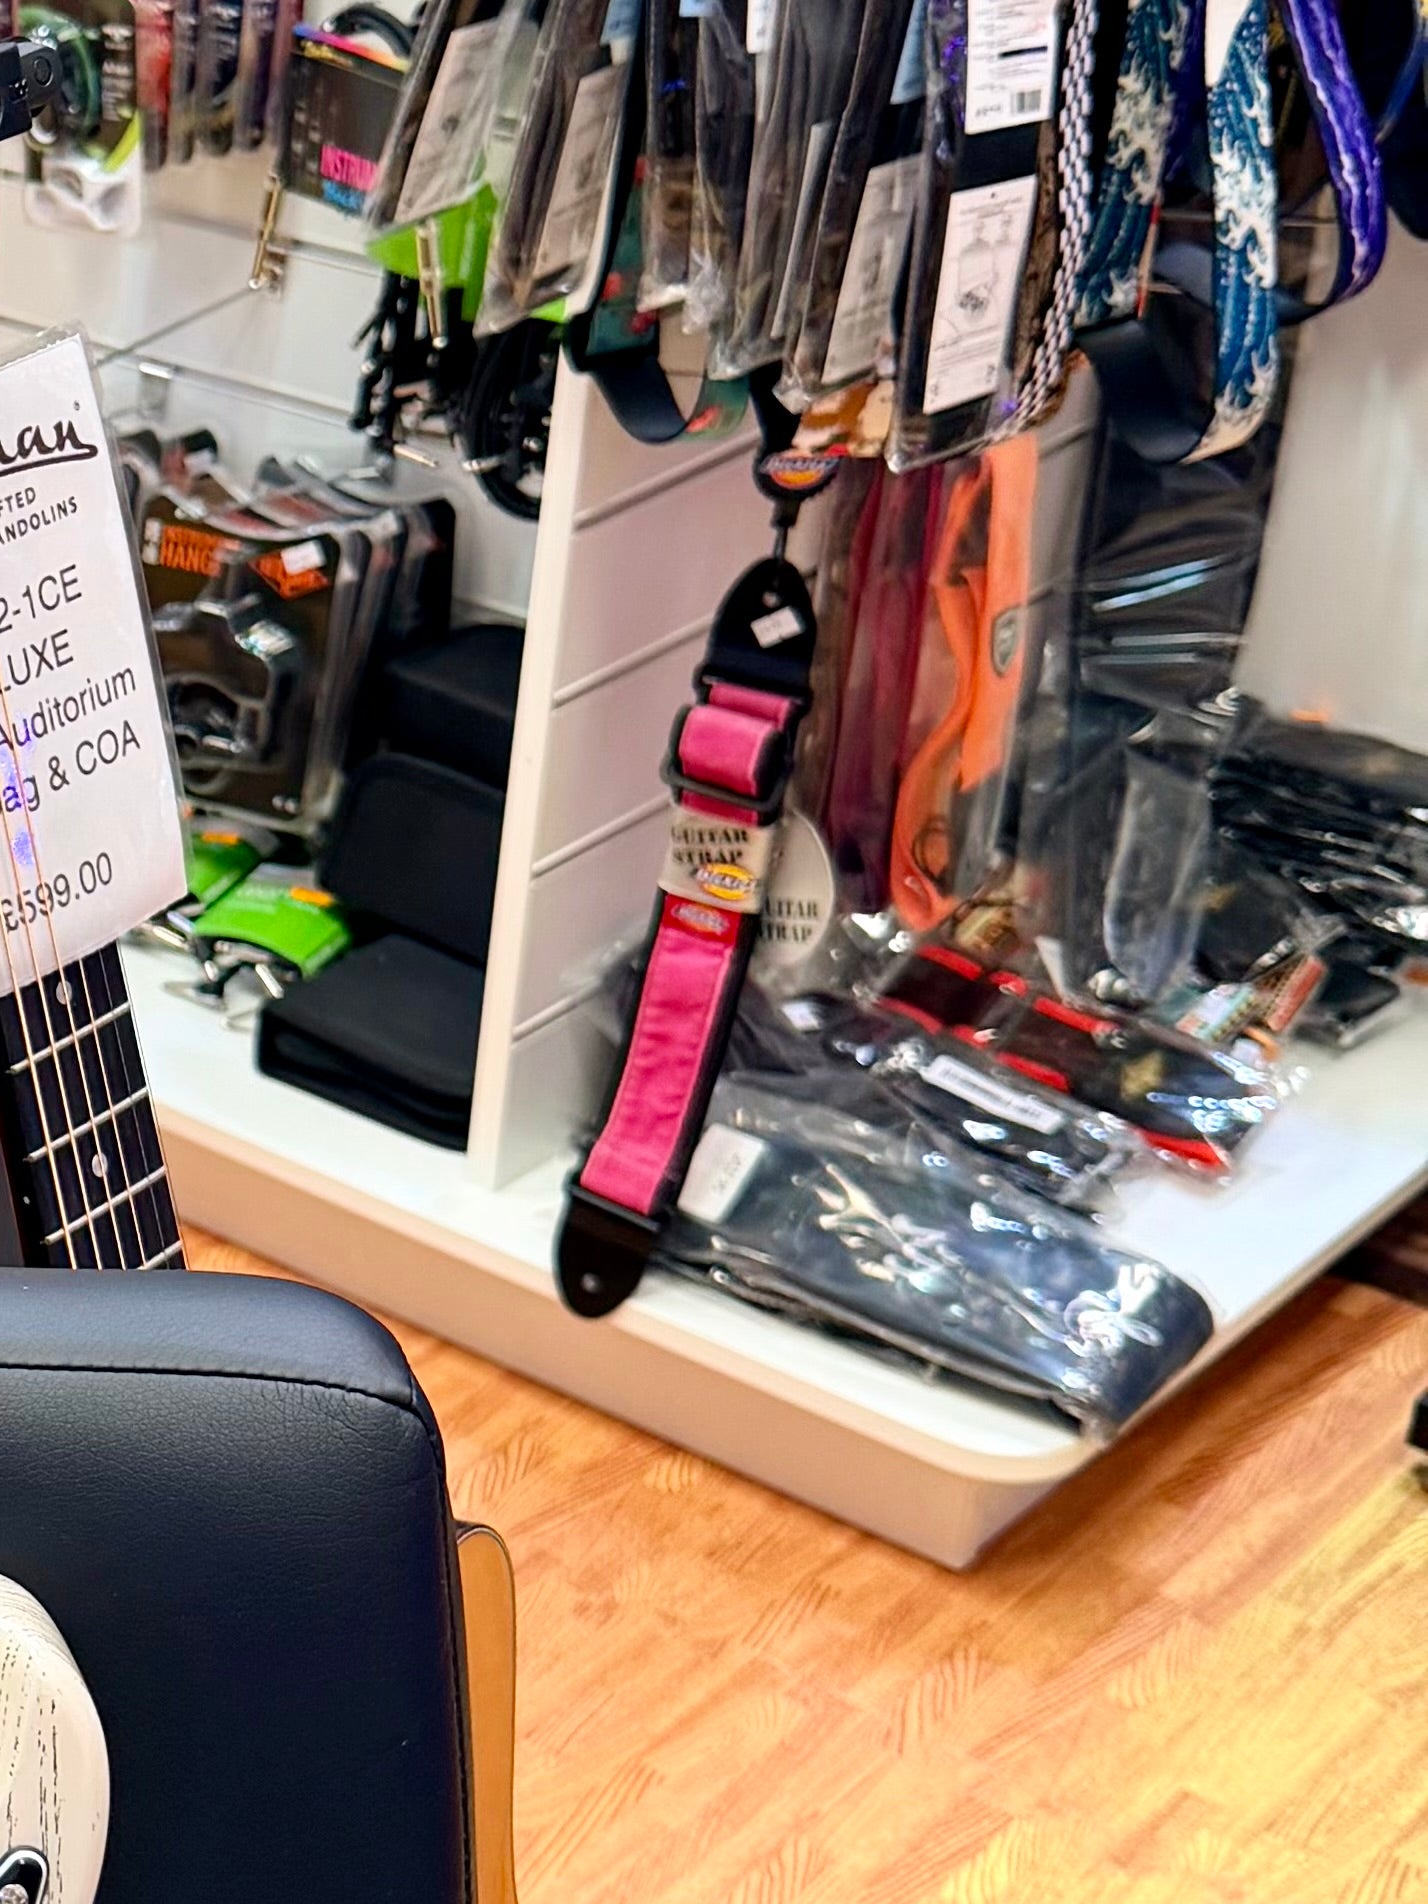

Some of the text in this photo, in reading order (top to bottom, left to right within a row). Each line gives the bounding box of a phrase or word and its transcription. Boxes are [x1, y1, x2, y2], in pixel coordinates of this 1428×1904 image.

[48, 754, 71, 792] &
[75, 718, 141, 776] COA
[672, 826, 749, 845] GUITAR
[673, 847, 743, 864] STRAP
[1, 851, 113, 933] £599.00
